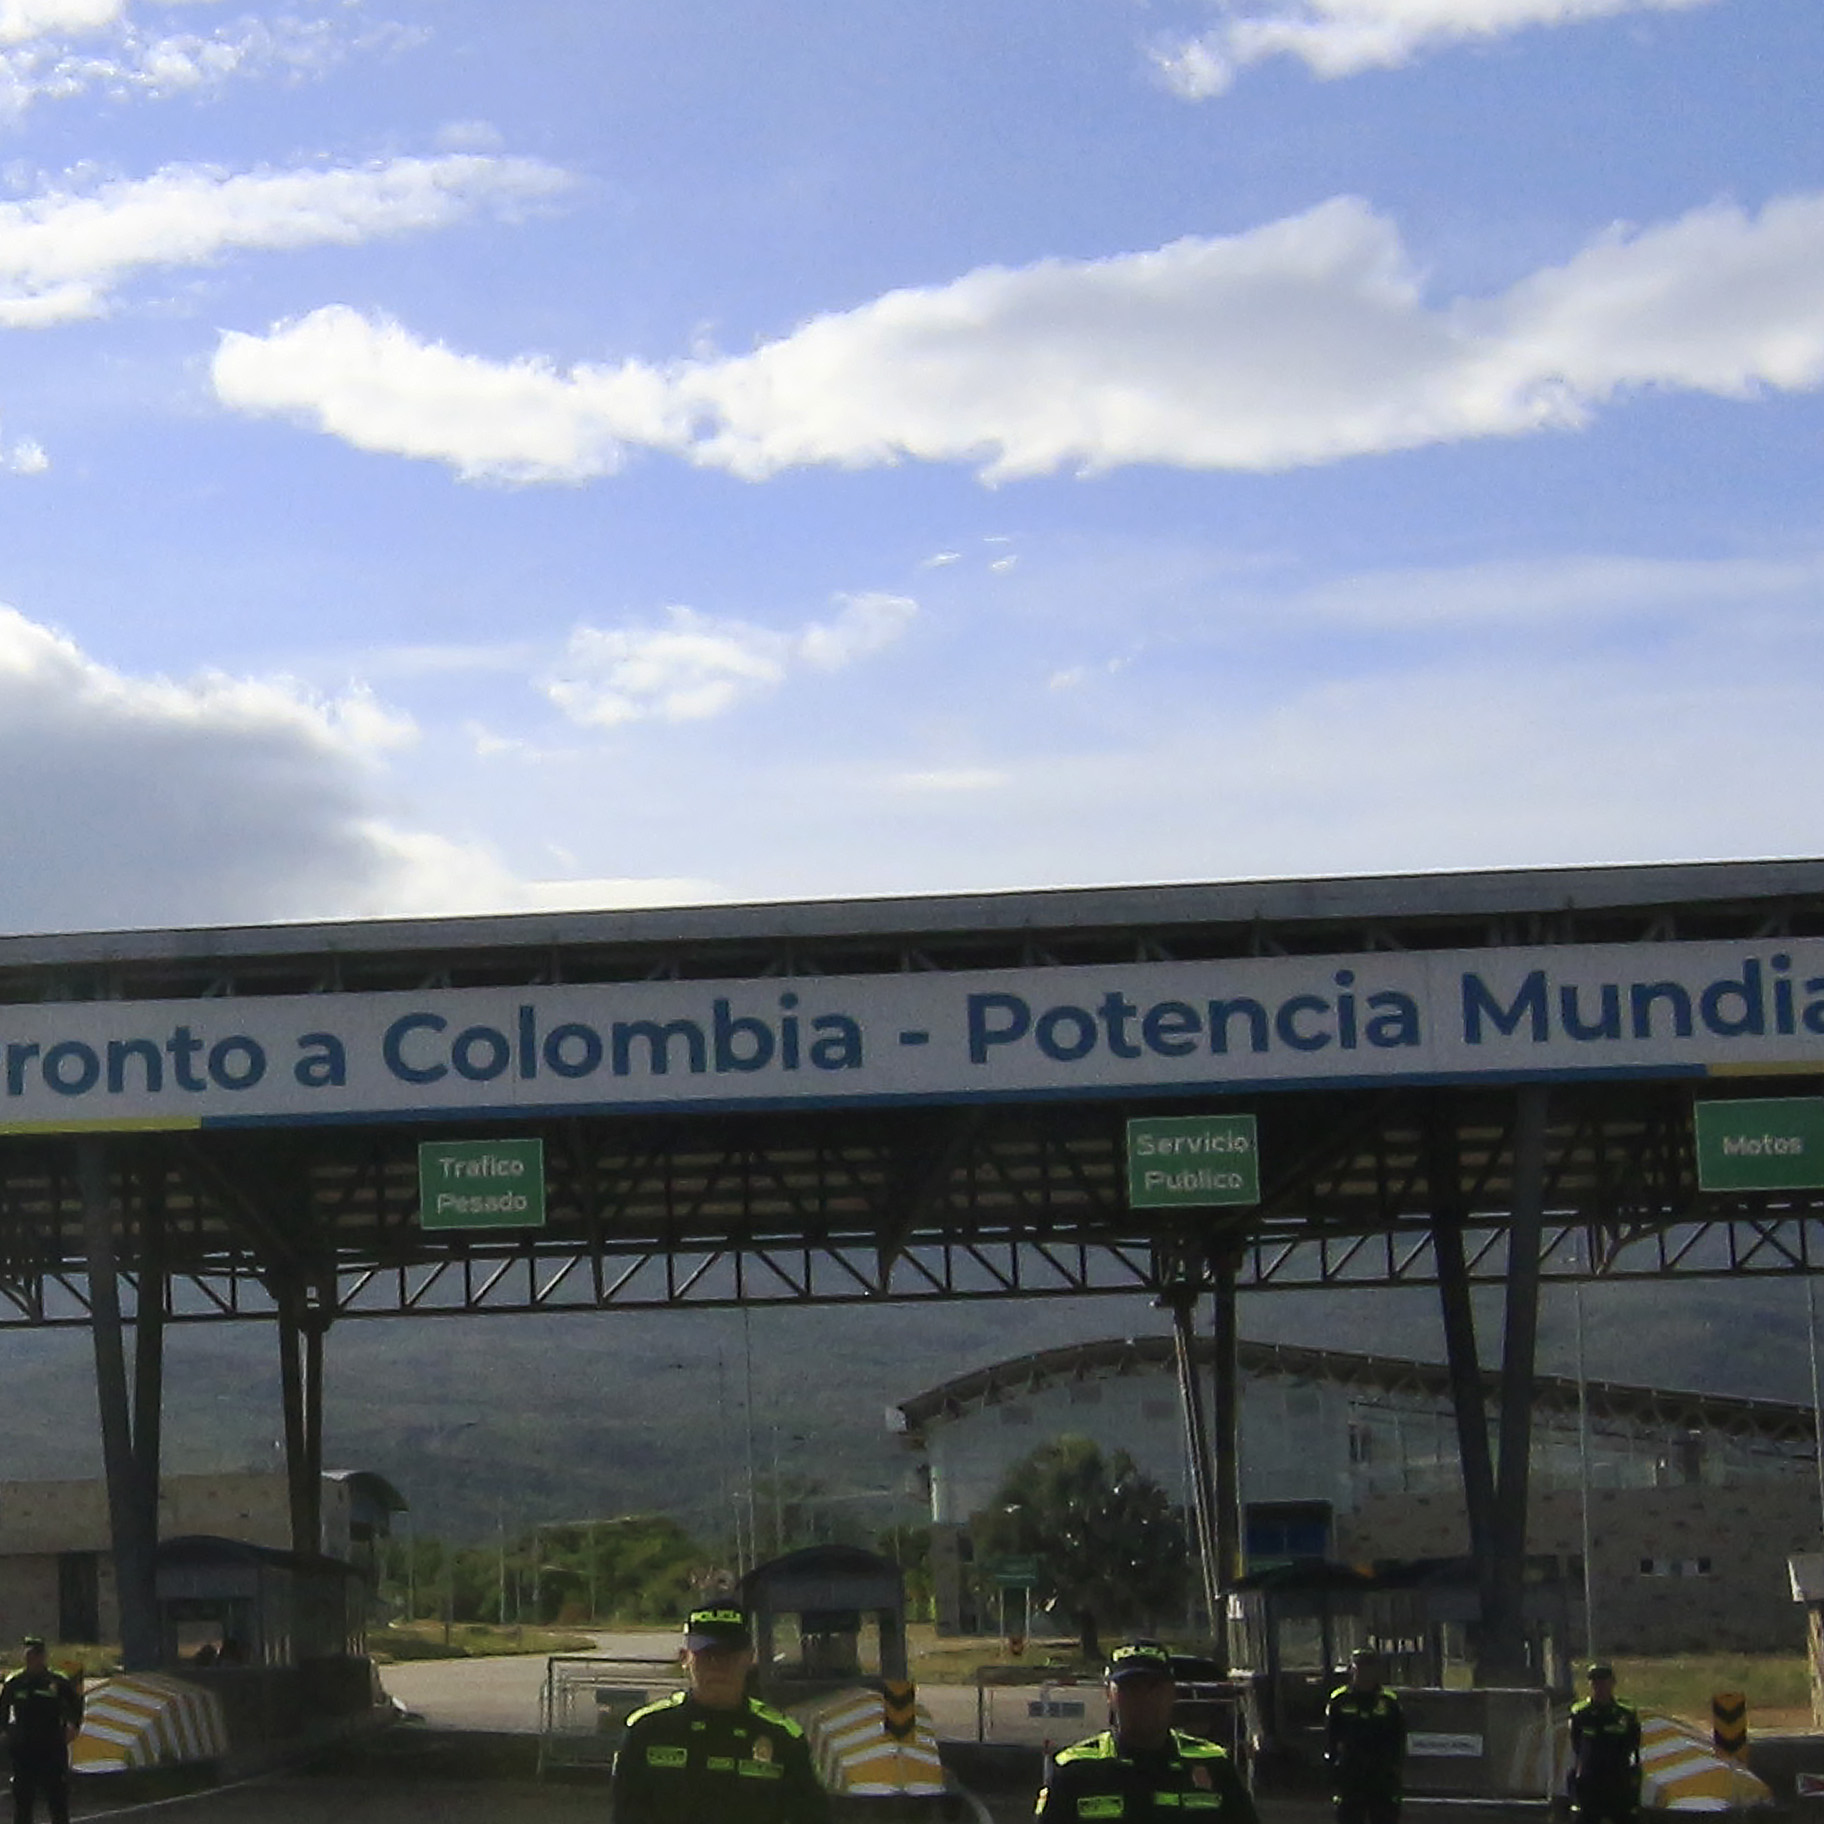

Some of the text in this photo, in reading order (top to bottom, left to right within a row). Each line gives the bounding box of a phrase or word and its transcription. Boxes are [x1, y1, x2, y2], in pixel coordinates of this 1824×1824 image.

[292, 1033, 349, 1088] a
[383, 993, 862, 1085] Colombia
[898, 1031, 928, 1048] -
[966, 971, 1421, 1064] Potencia
[1136, 1131, 1249, 1156] Servicio
[1723, 1134, 1805, 1155] Motos
[437, 1191, 528, 1214] Pesado
